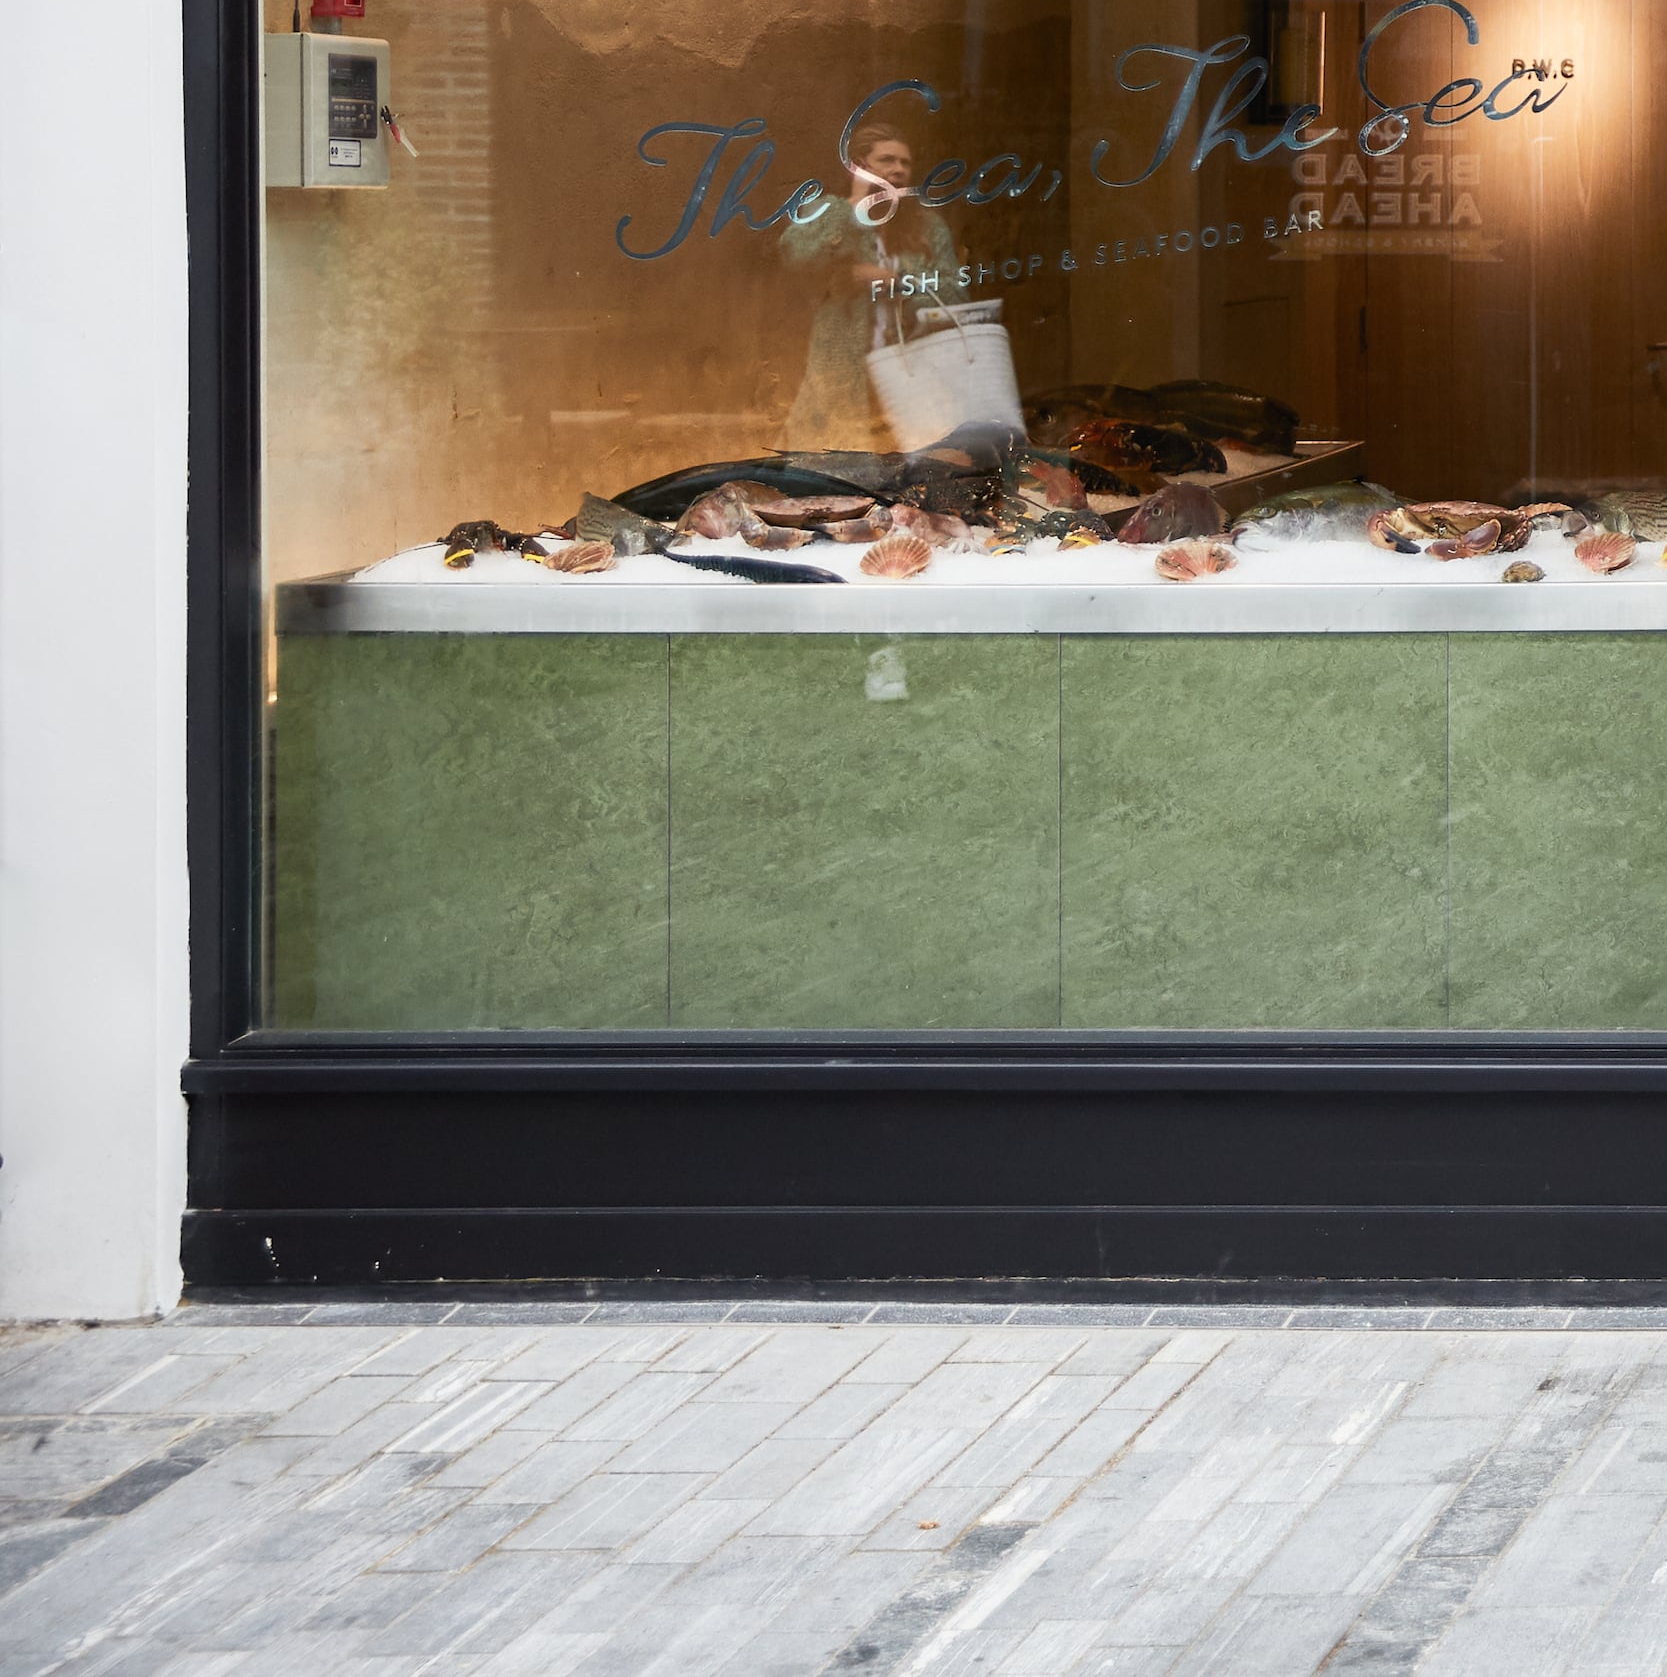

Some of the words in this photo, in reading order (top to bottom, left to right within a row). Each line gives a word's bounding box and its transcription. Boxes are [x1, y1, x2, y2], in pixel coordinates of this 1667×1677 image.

[615, 117, 832, 261] The
[838, 79, 1063, 227] Sea,
[1090, 34, 1340, 188] The
[870, 269, 940, 303] FISH
[957, 253, 1044, 288] SHOP
[1060, 249, 1079, 272] &
[1094, 222, 1245, 266] SEAFOOD
[1263, 209, 1324, 240] BAR
